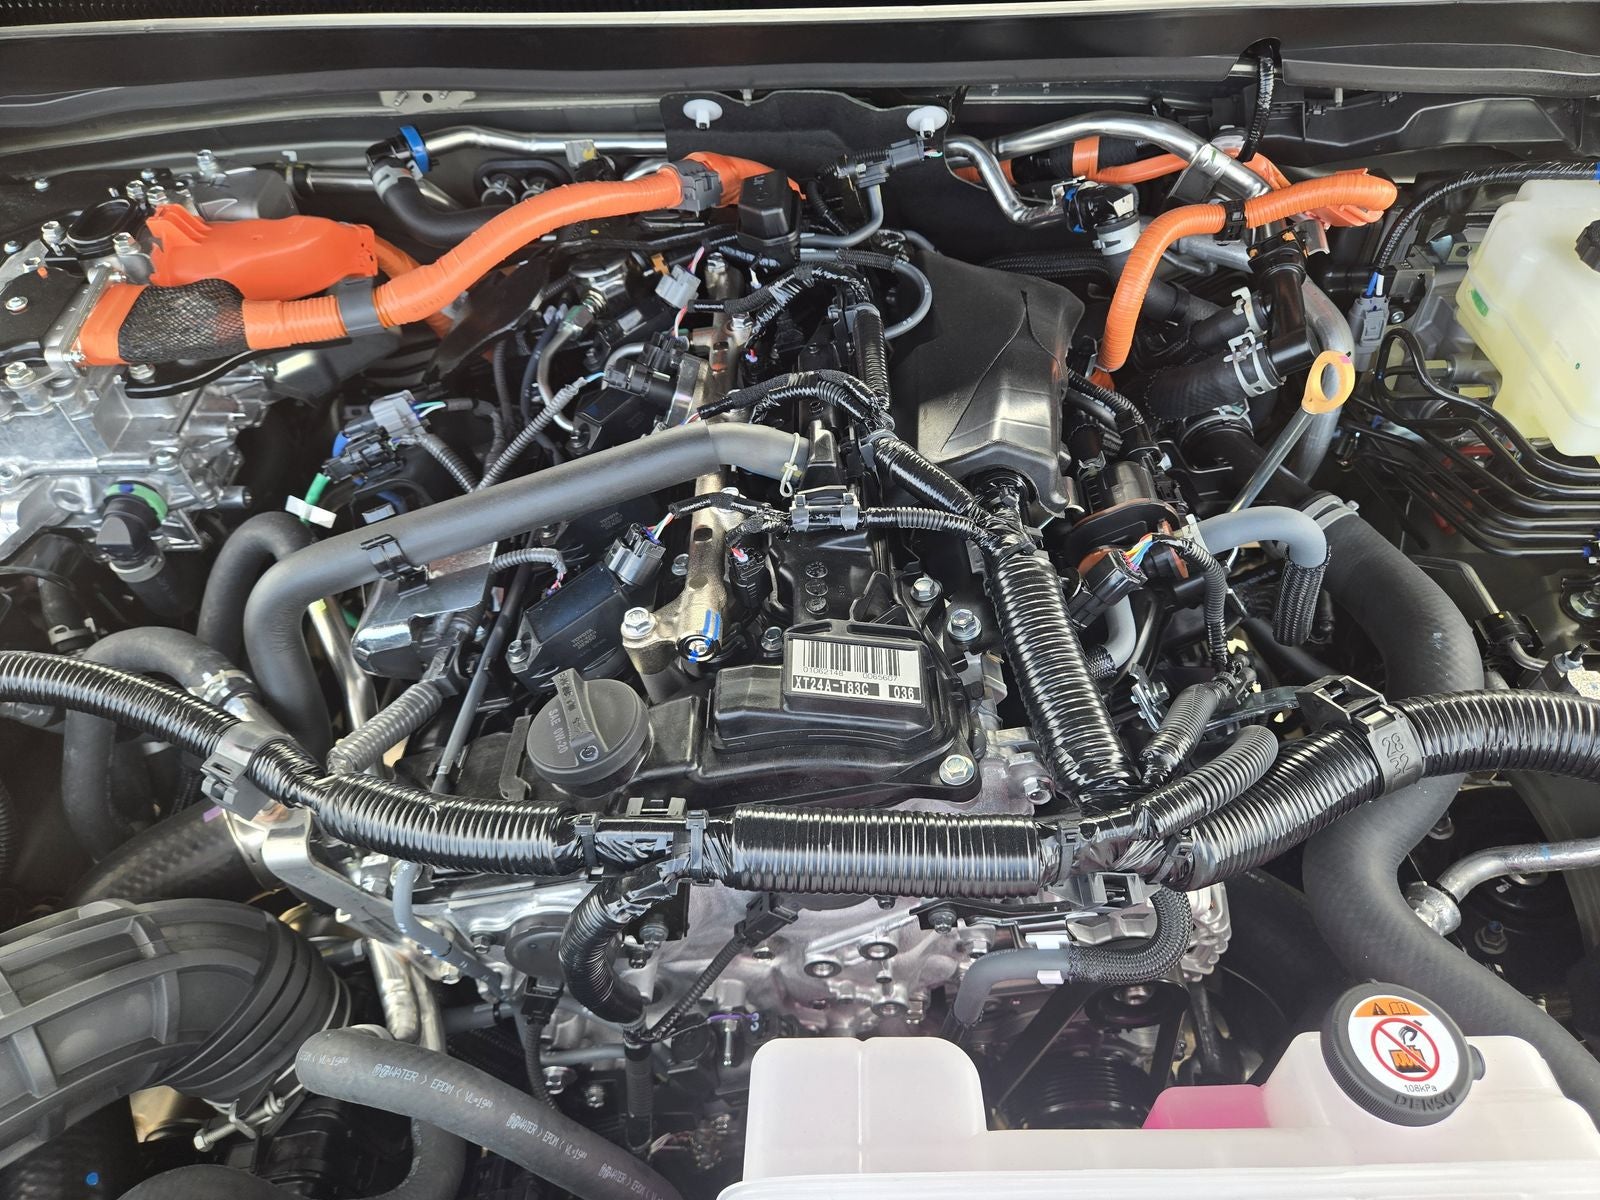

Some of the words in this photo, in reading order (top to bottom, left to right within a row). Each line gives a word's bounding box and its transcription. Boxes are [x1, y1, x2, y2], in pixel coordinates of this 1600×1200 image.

[794, 675, 870, 696] XT24A-T83C
[893, 685, 915, 700] 036
[548, 708, 561, 727] SAE
[1381, 732, 1404, 759] 28
[1389, 752, 1414, 778] 32
[430, 1078, 455, 1096] EPDM
[1404, 1083, 1438, 1093] 108kPa
[1394, 1091, 1456, 1112] DENSO
